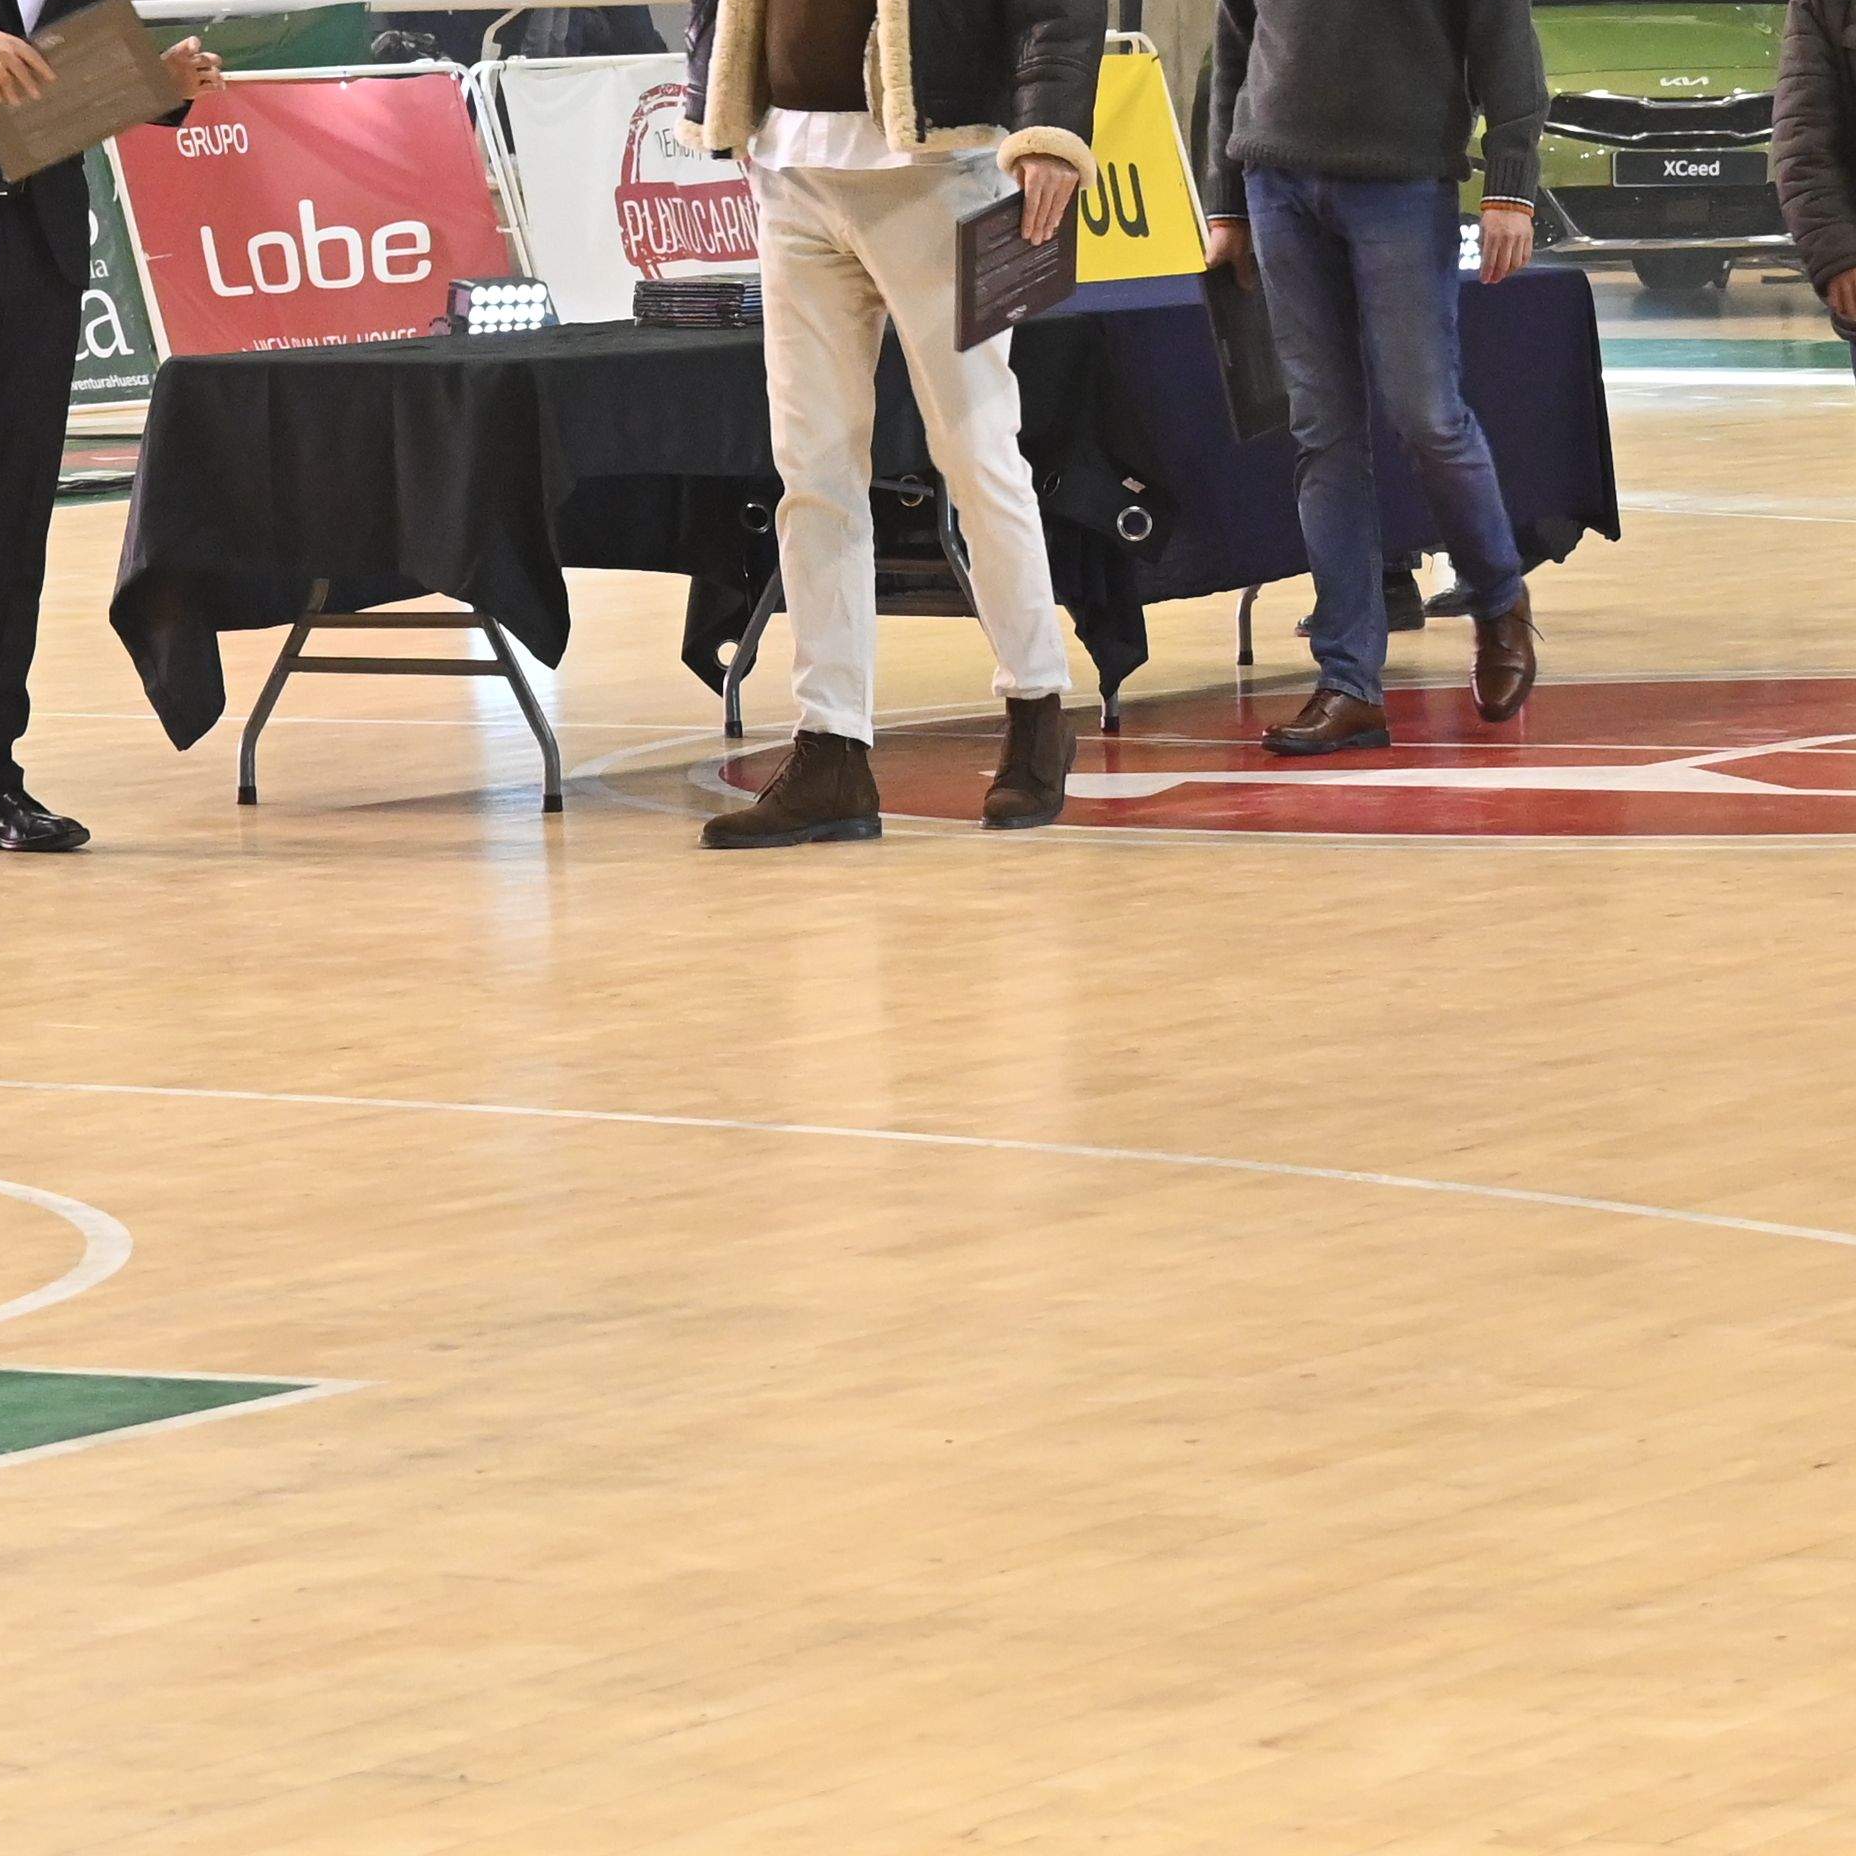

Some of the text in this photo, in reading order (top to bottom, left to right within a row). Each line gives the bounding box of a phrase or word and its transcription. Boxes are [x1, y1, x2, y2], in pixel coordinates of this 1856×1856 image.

[176, 123, 249, 158] GRUPO
[1663, 159, 1721, 177] XCeed
[200, 198, 433, 298] Lobe
